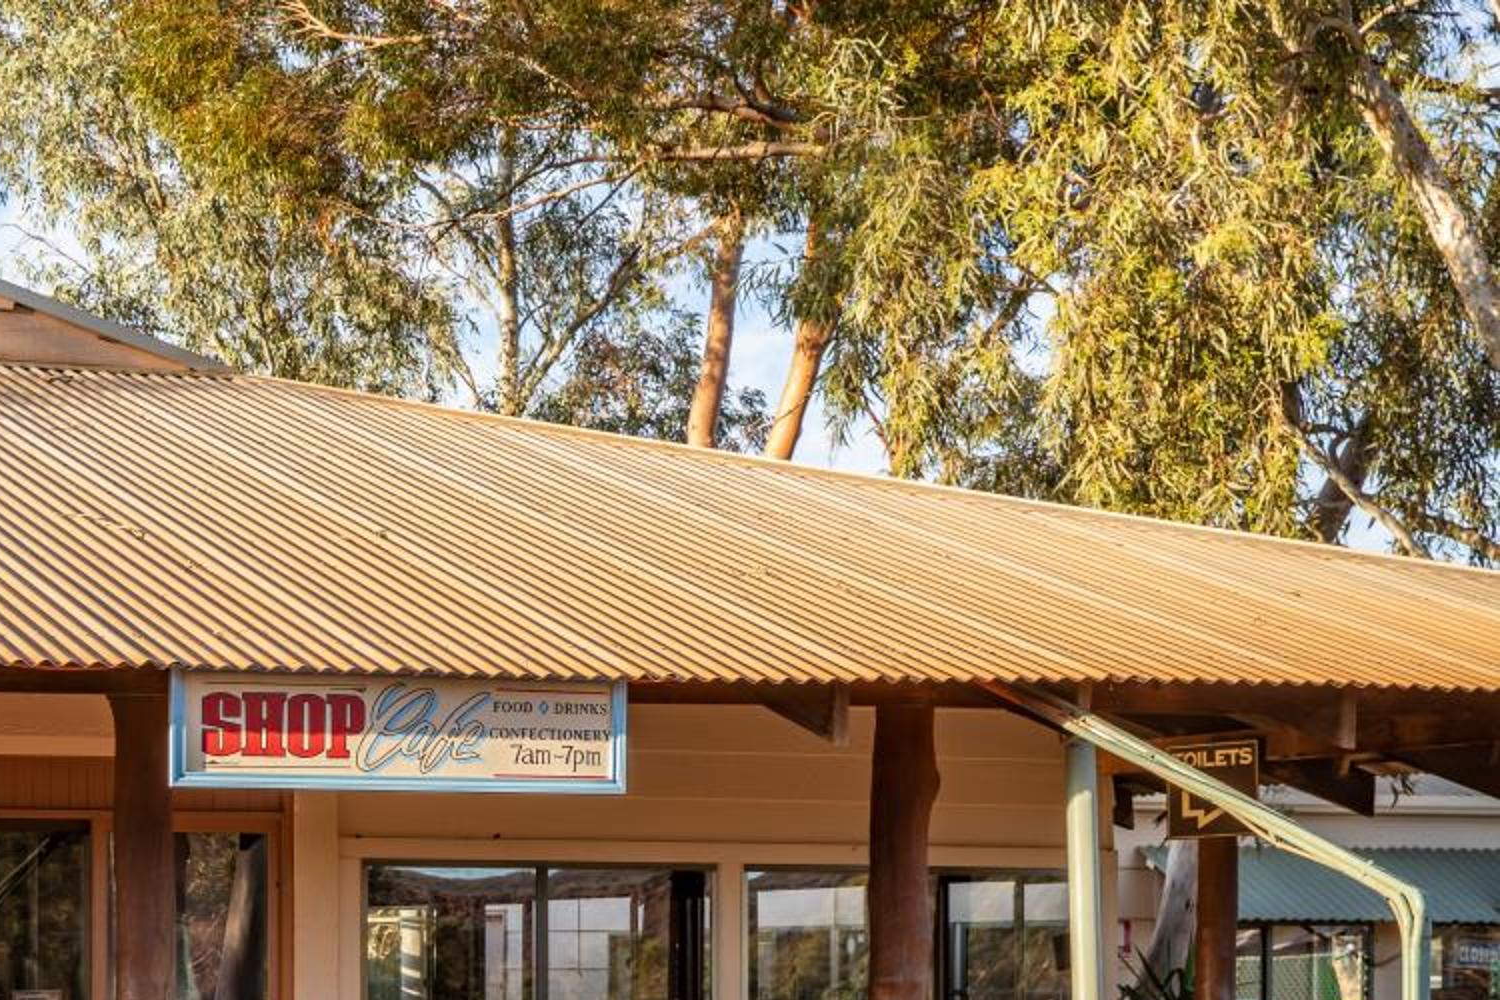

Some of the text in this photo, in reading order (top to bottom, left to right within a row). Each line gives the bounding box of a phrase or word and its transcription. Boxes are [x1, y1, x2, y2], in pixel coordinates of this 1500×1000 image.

[493, 701, 608, 715] FOOD DRINKS
[202, 691, 366, 758] SHOP
[489, 727, 611, 741] CONFECTIONERY
